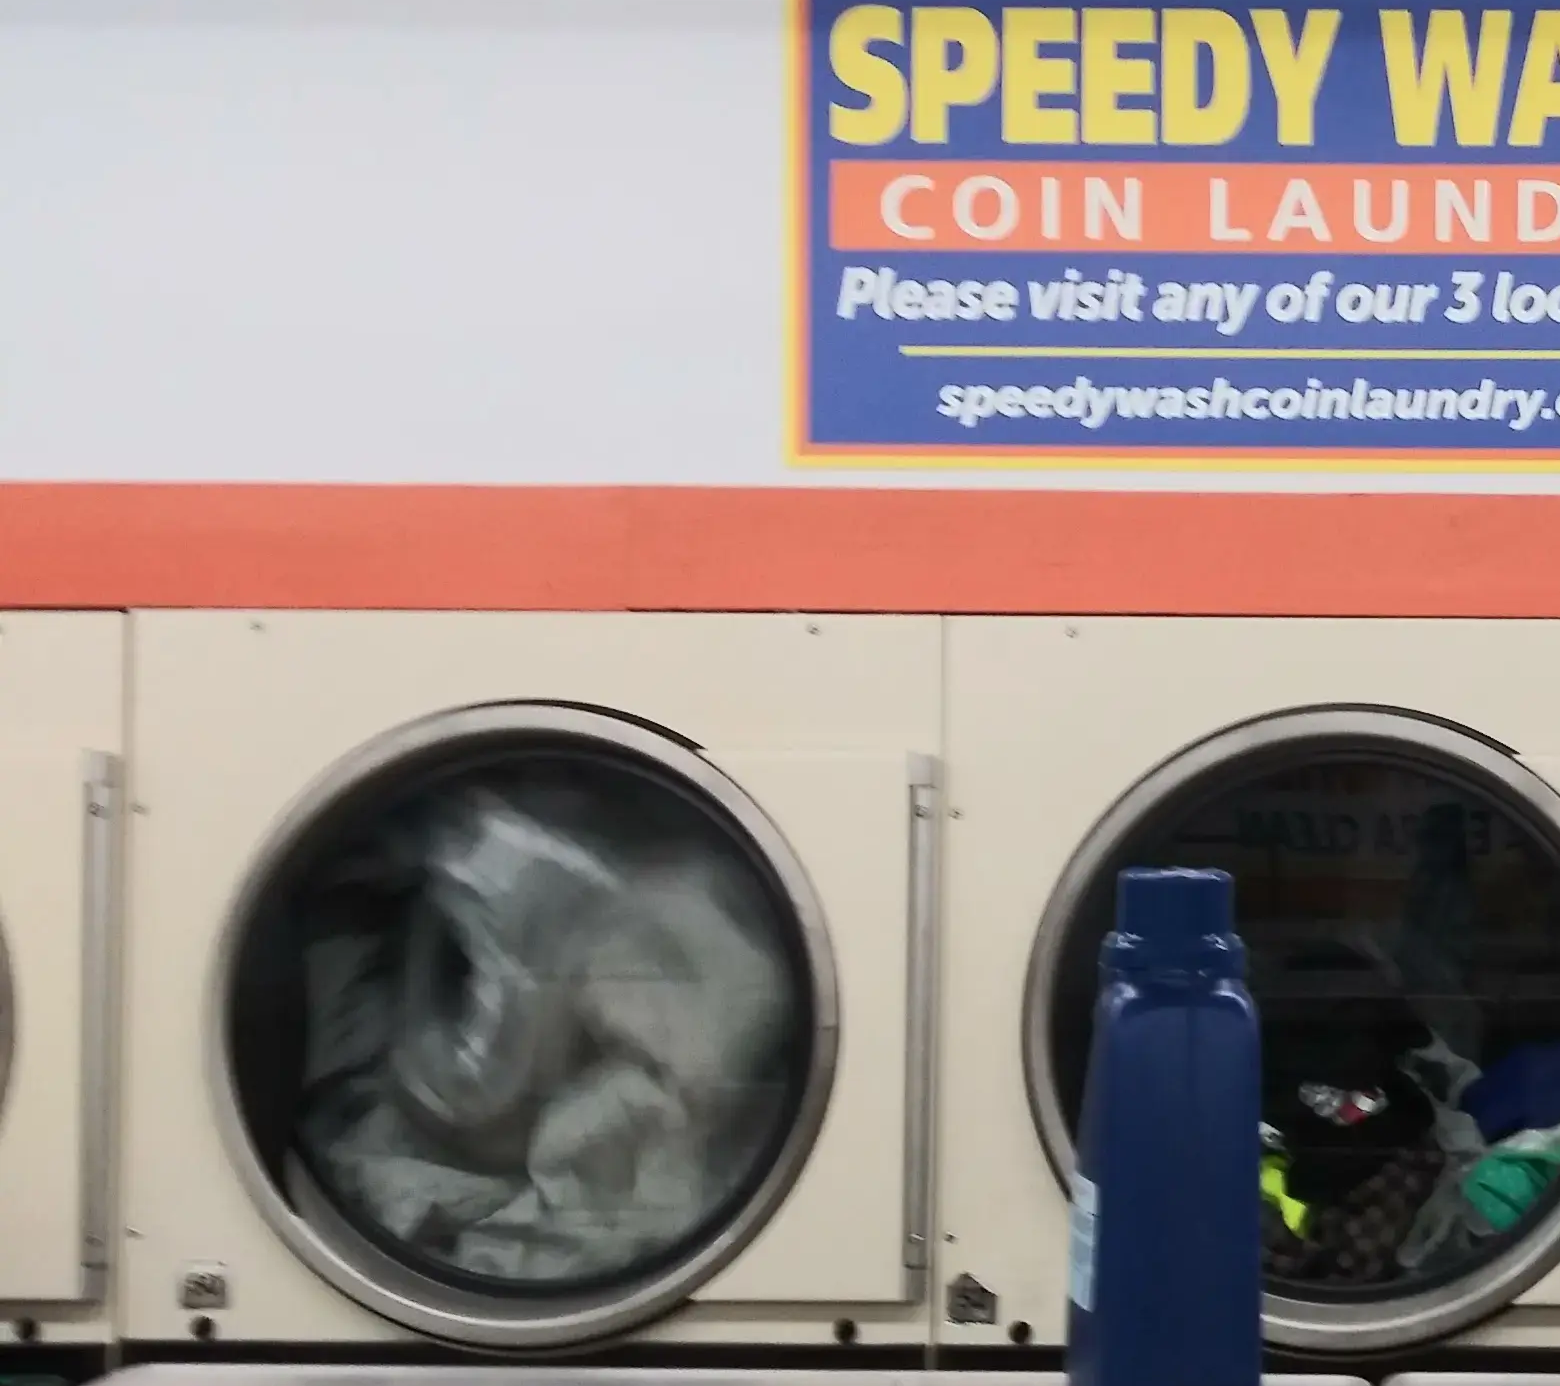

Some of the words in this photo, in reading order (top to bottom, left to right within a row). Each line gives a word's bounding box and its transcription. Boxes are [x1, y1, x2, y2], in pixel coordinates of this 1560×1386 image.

[830, 6, 1340, 145] SPEEDY
[881, 175, 1141, 240] COIN
[837, 267, 1019, 320] Please
[1028, 269, 1148, 321] visit
[1152, 282, 1258, 335] any
[1266, 271, 1334, 322] of
[1331, 273, 1439, 323] our
[1444, 272, 1484, 323] 3
